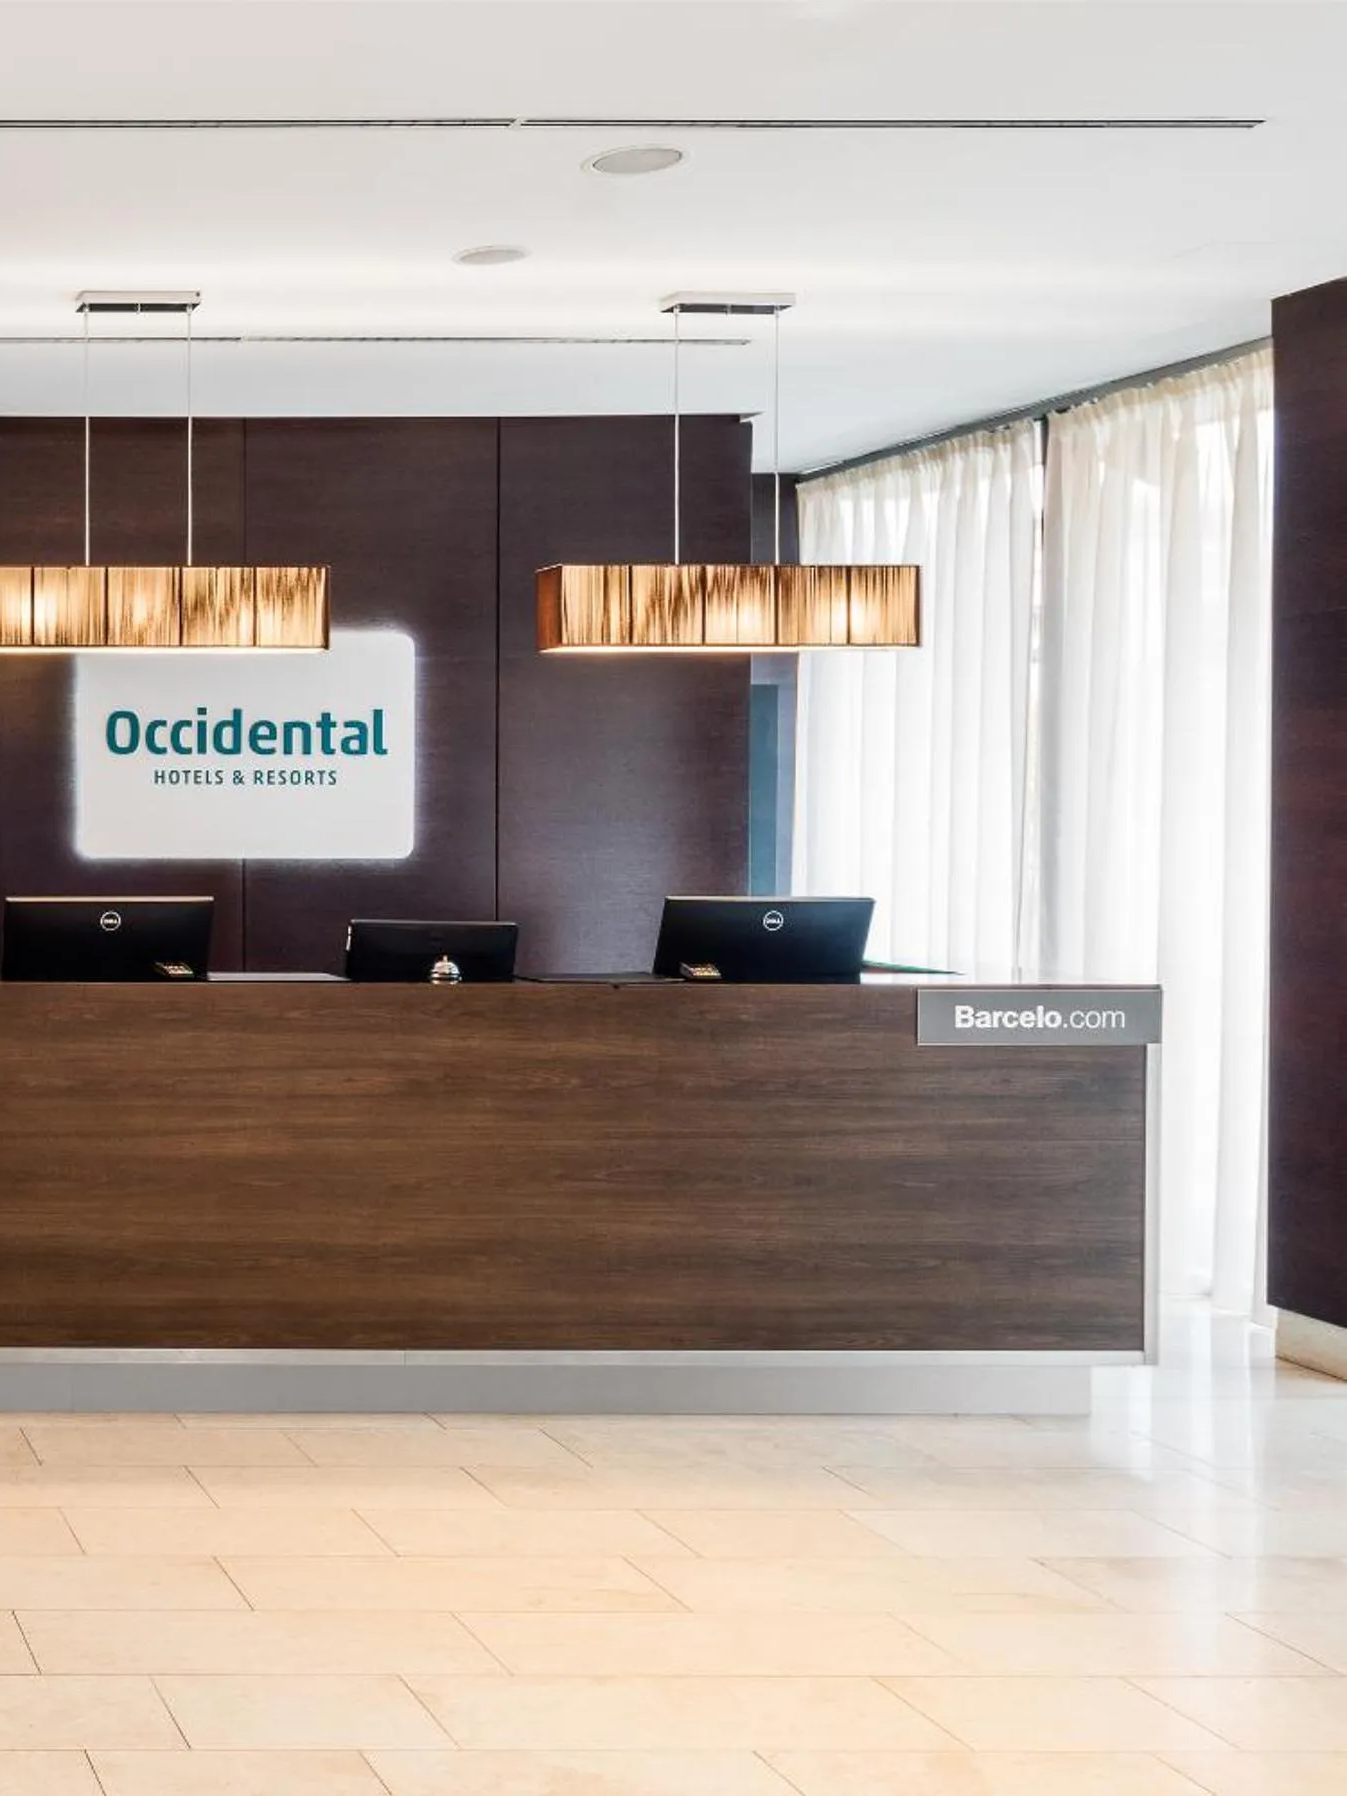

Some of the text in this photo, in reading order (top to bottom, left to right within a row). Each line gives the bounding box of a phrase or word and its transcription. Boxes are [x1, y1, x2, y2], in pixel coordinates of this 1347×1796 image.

[106, 707, 388, 755] Occidental
[153, 769, 338, 786] HOTELS & RESORTS
[955, 1005, 1125, 1029] Barcelo.com
